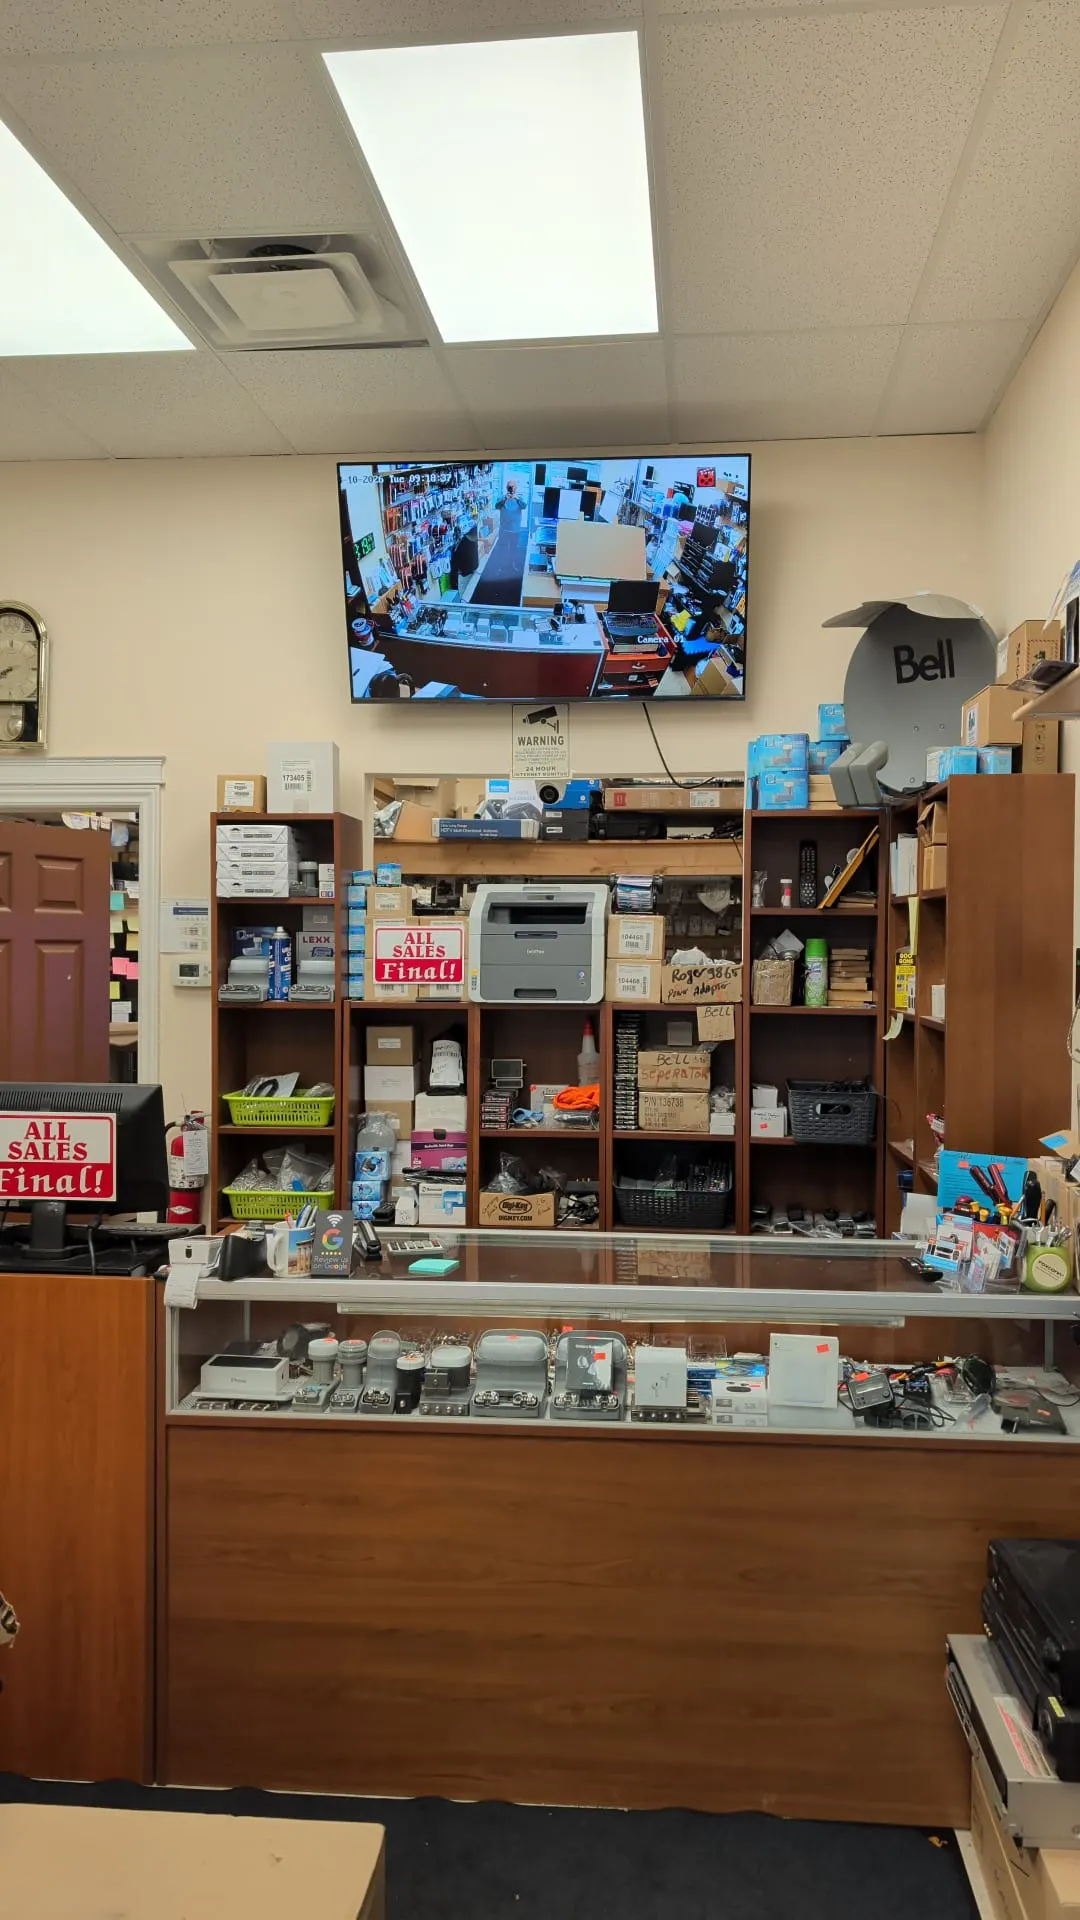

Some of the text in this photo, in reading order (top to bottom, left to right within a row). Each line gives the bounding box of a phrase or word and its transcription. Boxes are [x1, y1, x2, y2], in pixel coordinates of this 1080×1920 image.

[637, 634, 684, 644] Camera 01
[893, 638, 955, 685] Bell
[517, 735, 564, 746] WARNING
[282, 774, 305, 782] 173405
[302, 936, 331, 944] LEXX
[403, 932, 435, 945] ALL
[392, 945, 446, 958] SALES
[381, 960, 456, 980] Final!
[671, 968, 707, 985] Roger
[24, 1121, 71, 1141] ALL
[7, 1141, 88, 1161] SALES
[313, 1256, 339, 1264] Review
[324, 1262, 348, 1271] Google
